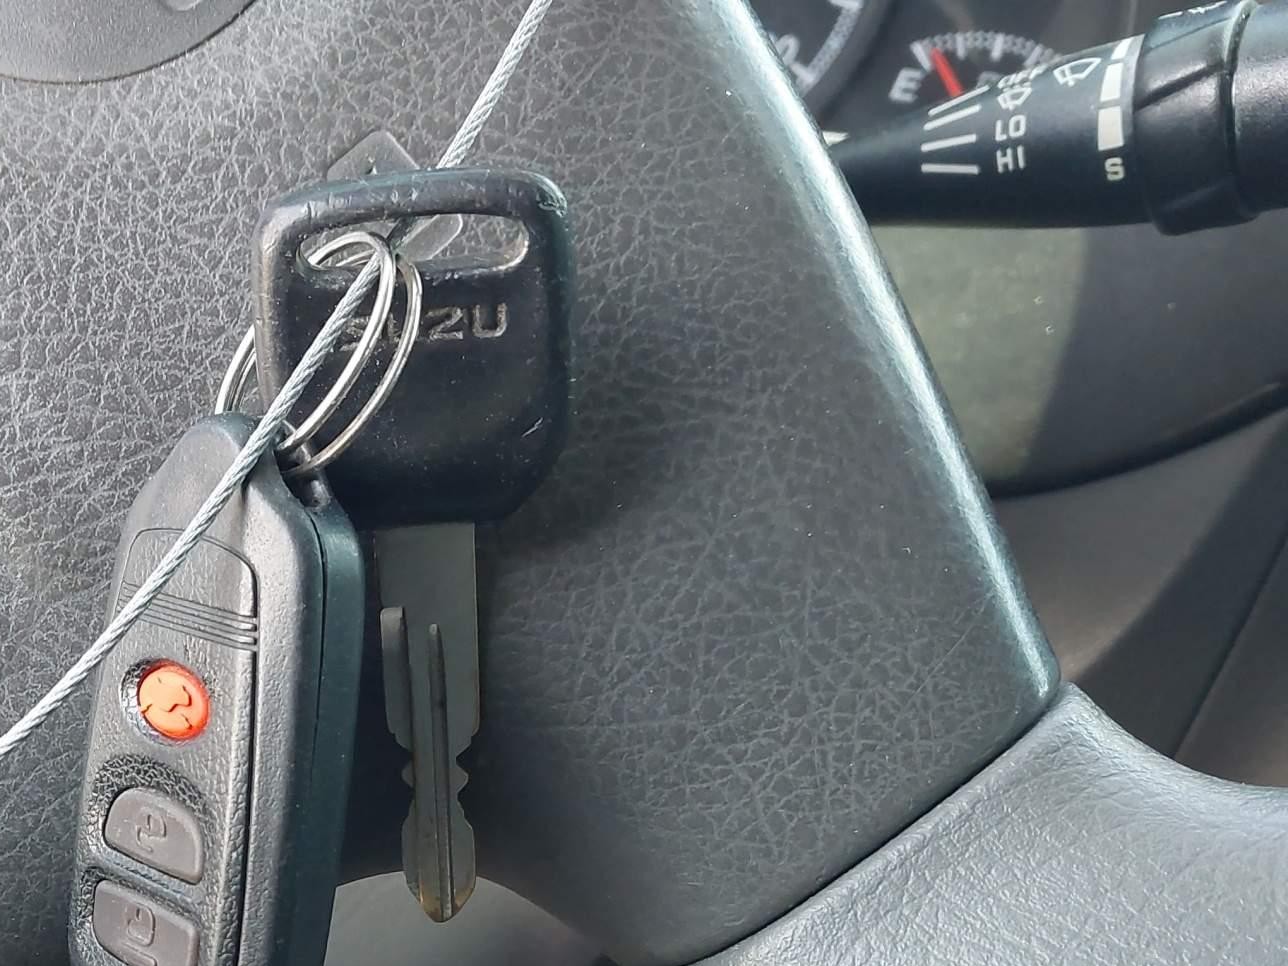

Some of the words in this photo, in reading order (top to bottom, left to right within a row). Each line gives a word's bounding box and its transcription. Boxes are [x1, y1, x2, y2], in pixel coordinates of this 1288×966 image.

[890, 66, 922, 101] E
[995, 115, 1026, 140] LO
[996, 146, 1025, 172] HI
[1104, 157, 1125, 181] S
